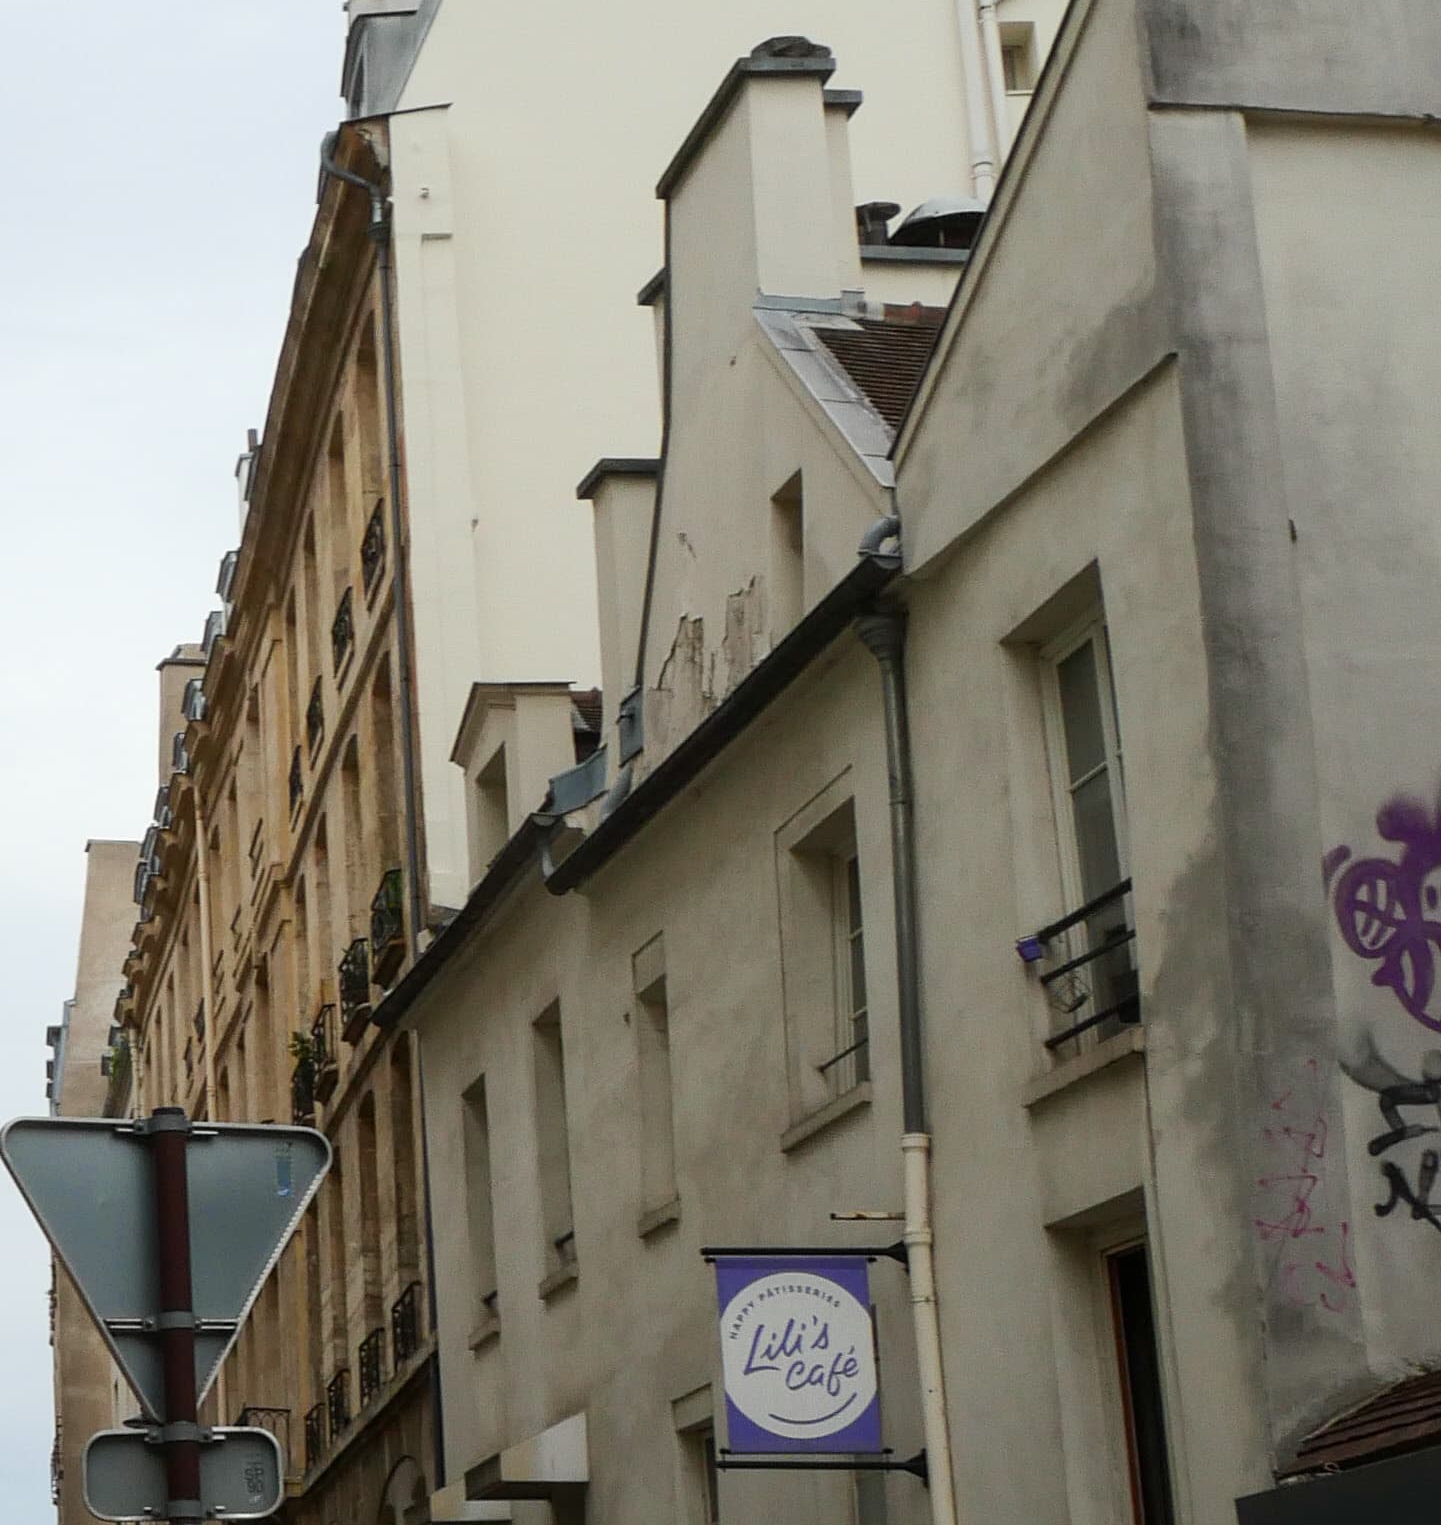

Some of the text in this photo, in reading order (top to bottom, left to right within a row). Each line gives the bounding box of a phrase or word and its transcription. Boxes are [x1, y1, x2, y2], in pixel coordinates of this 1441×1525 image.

[729, 1285, 841, 1340] HAPPY PÂTISSERIES
[743, 1315, 830, 1376] Lili's
